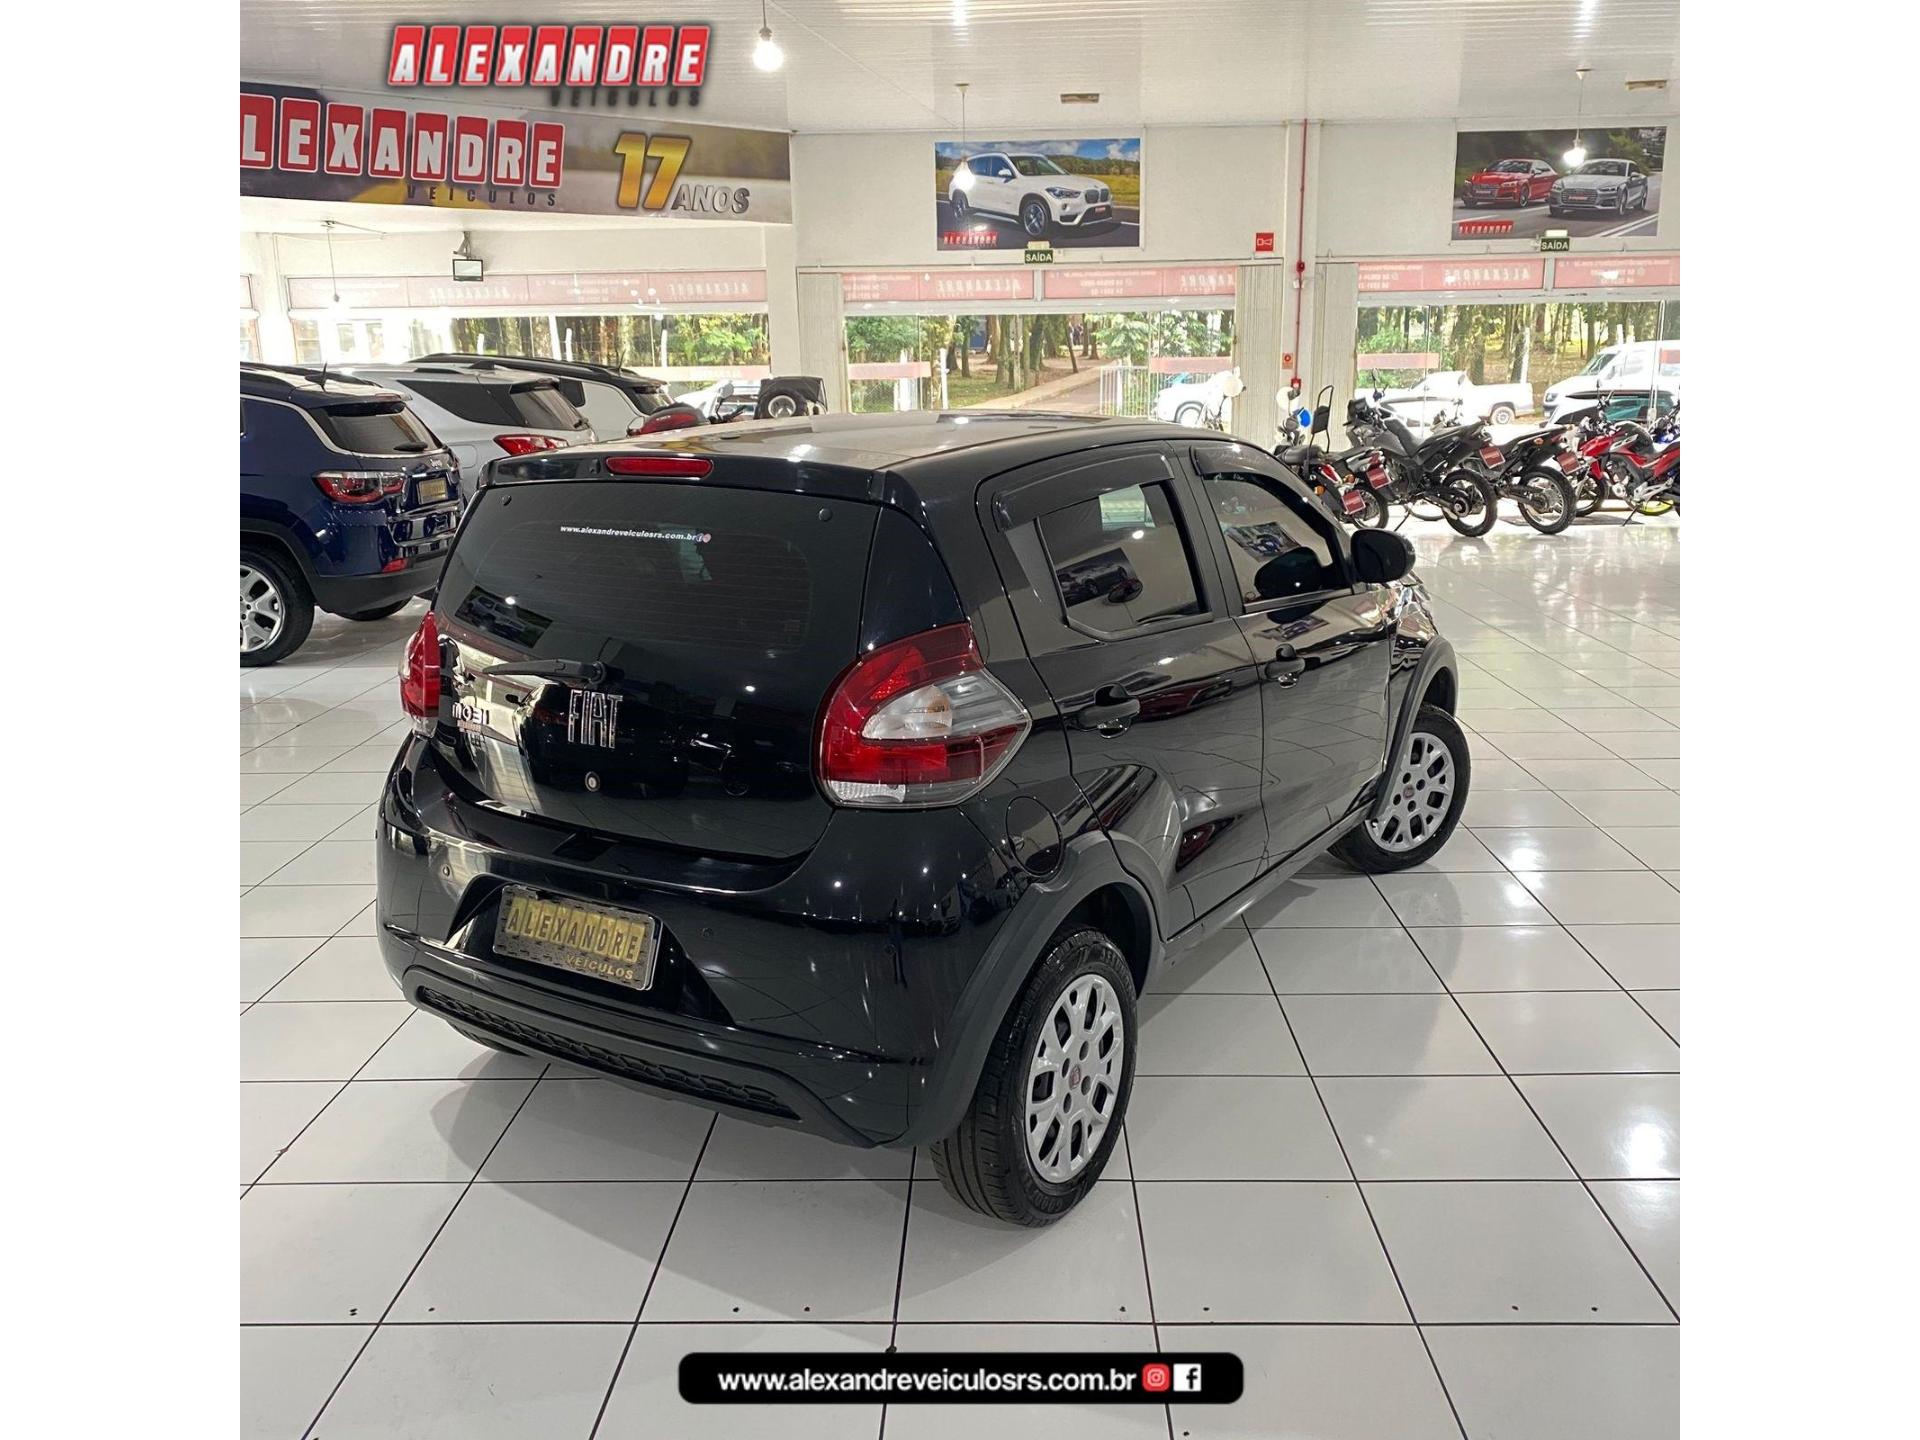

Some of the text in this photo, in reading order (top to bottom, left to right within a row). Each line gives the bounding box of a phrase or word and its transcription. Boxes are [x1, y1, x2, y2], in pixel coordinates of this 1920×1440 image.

[613, 132, 692, 209] 17
[671, 184, 750, 214] ANOS
[1025, 250, 1053, 262] SAÍDA
[1541, 239, 1569, 250] SAÍDA
[560, 525, 696, 541] www.alexandreveiculosrs.com.br
[568, 688, 624, 749] FIAT
[507, 907, 640, 962] ALEXANDRE
